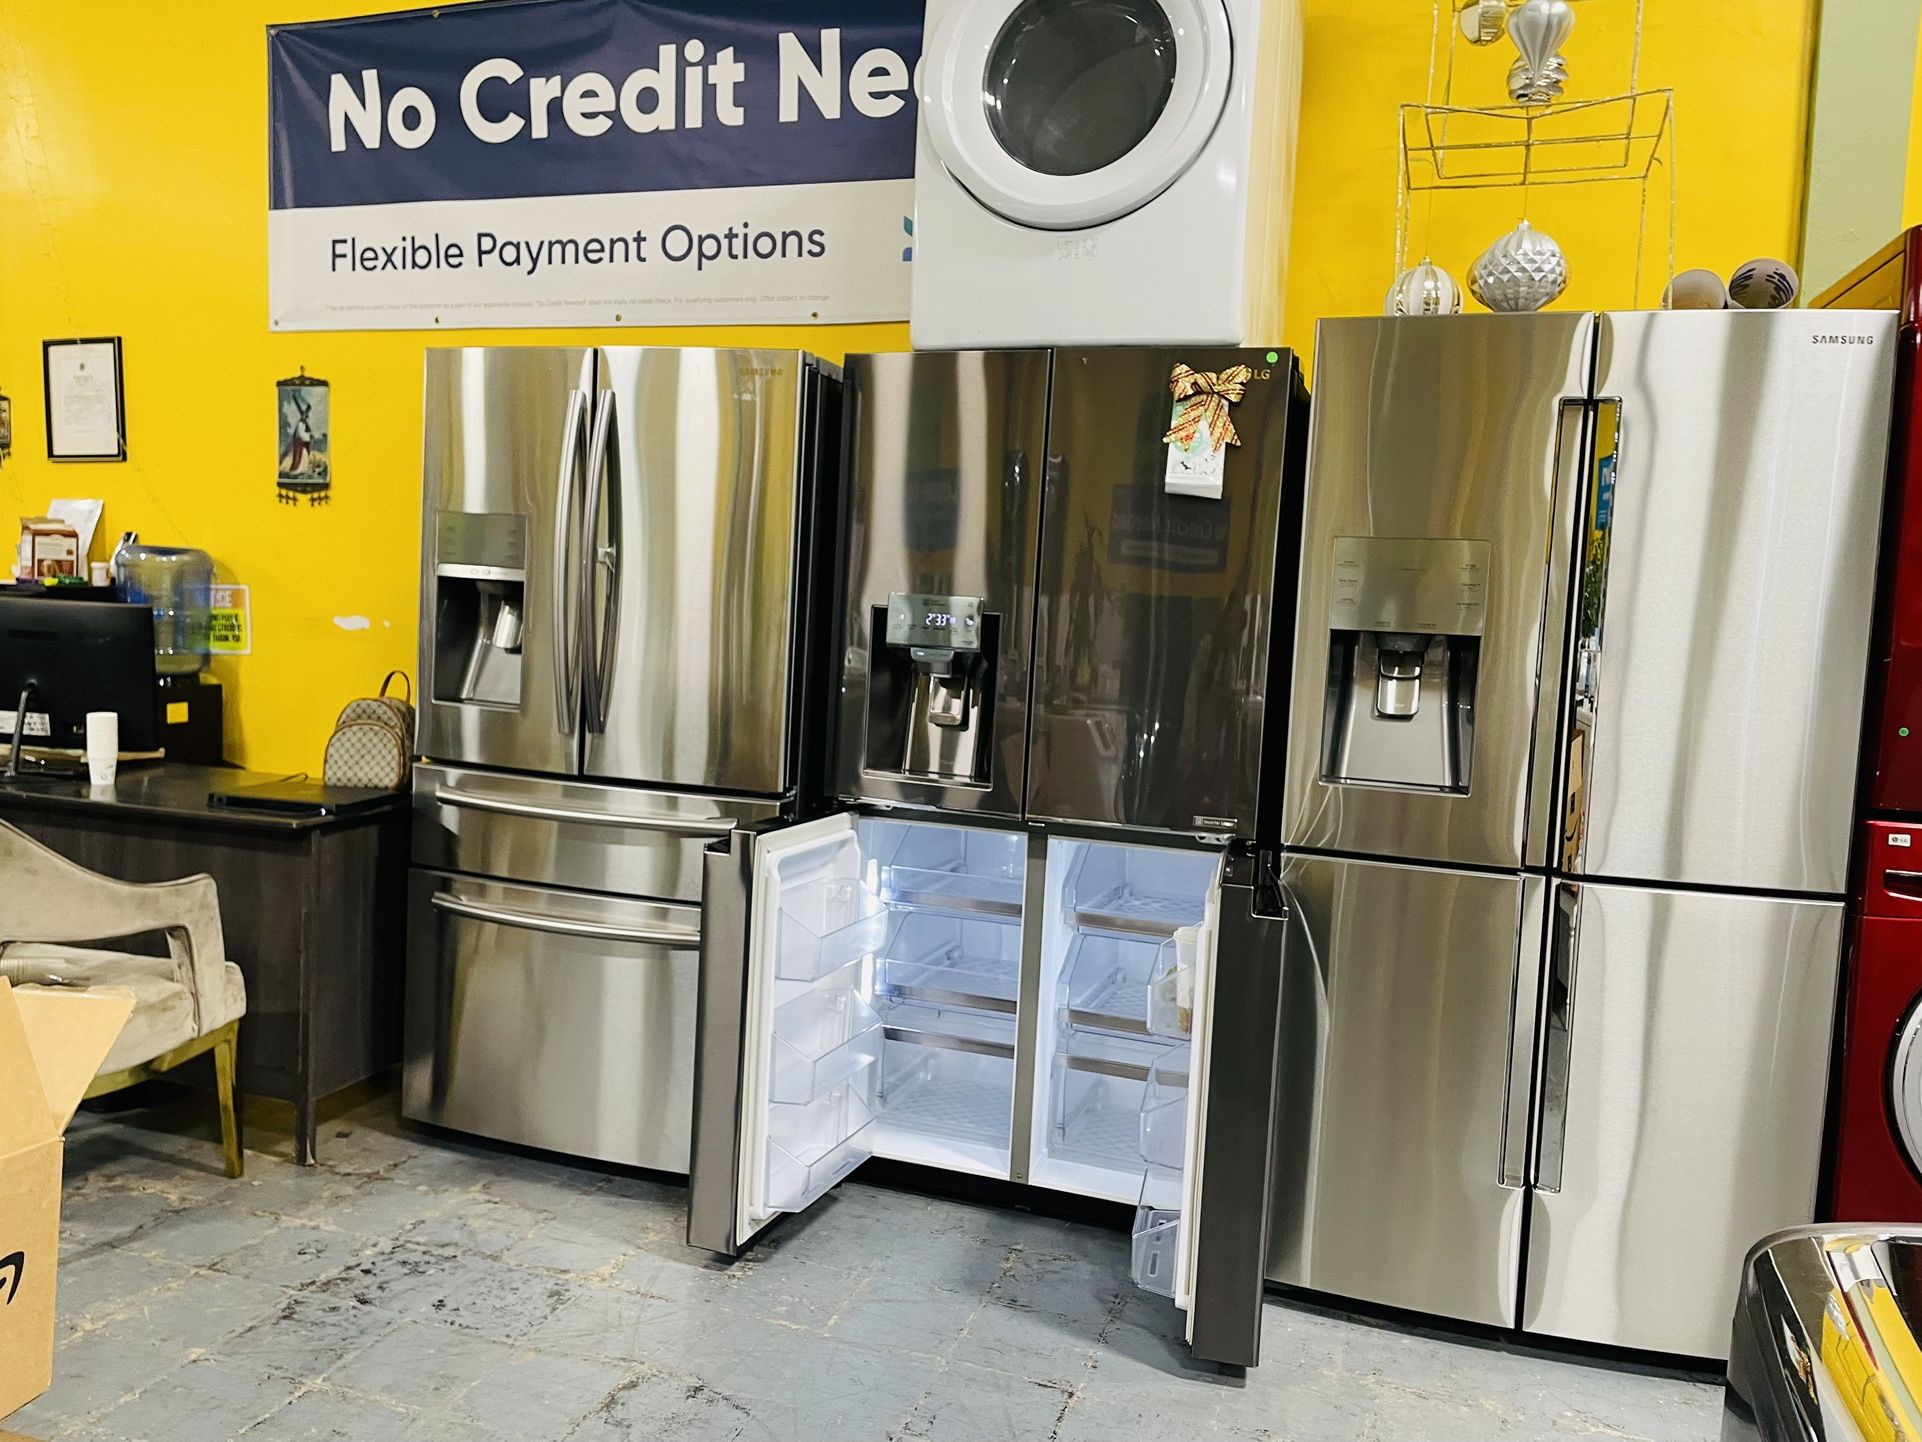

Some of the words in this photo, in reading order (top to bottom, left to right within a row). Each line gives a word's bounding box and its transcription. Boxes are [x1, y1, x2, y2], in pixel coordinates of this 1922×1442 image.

[328, 69, 436, 152] No
[459, 39, 745, 143] Credit
[778, 27, 922, 123] Ne
[331, 234, 464, 273] Flexible
[477, 230, 646, 276] Payment
[661, 224, 826, 271] Options
[1811, 334, 1874, 345] SAMSUNG
[1253, 369, 1271, 380] LG
